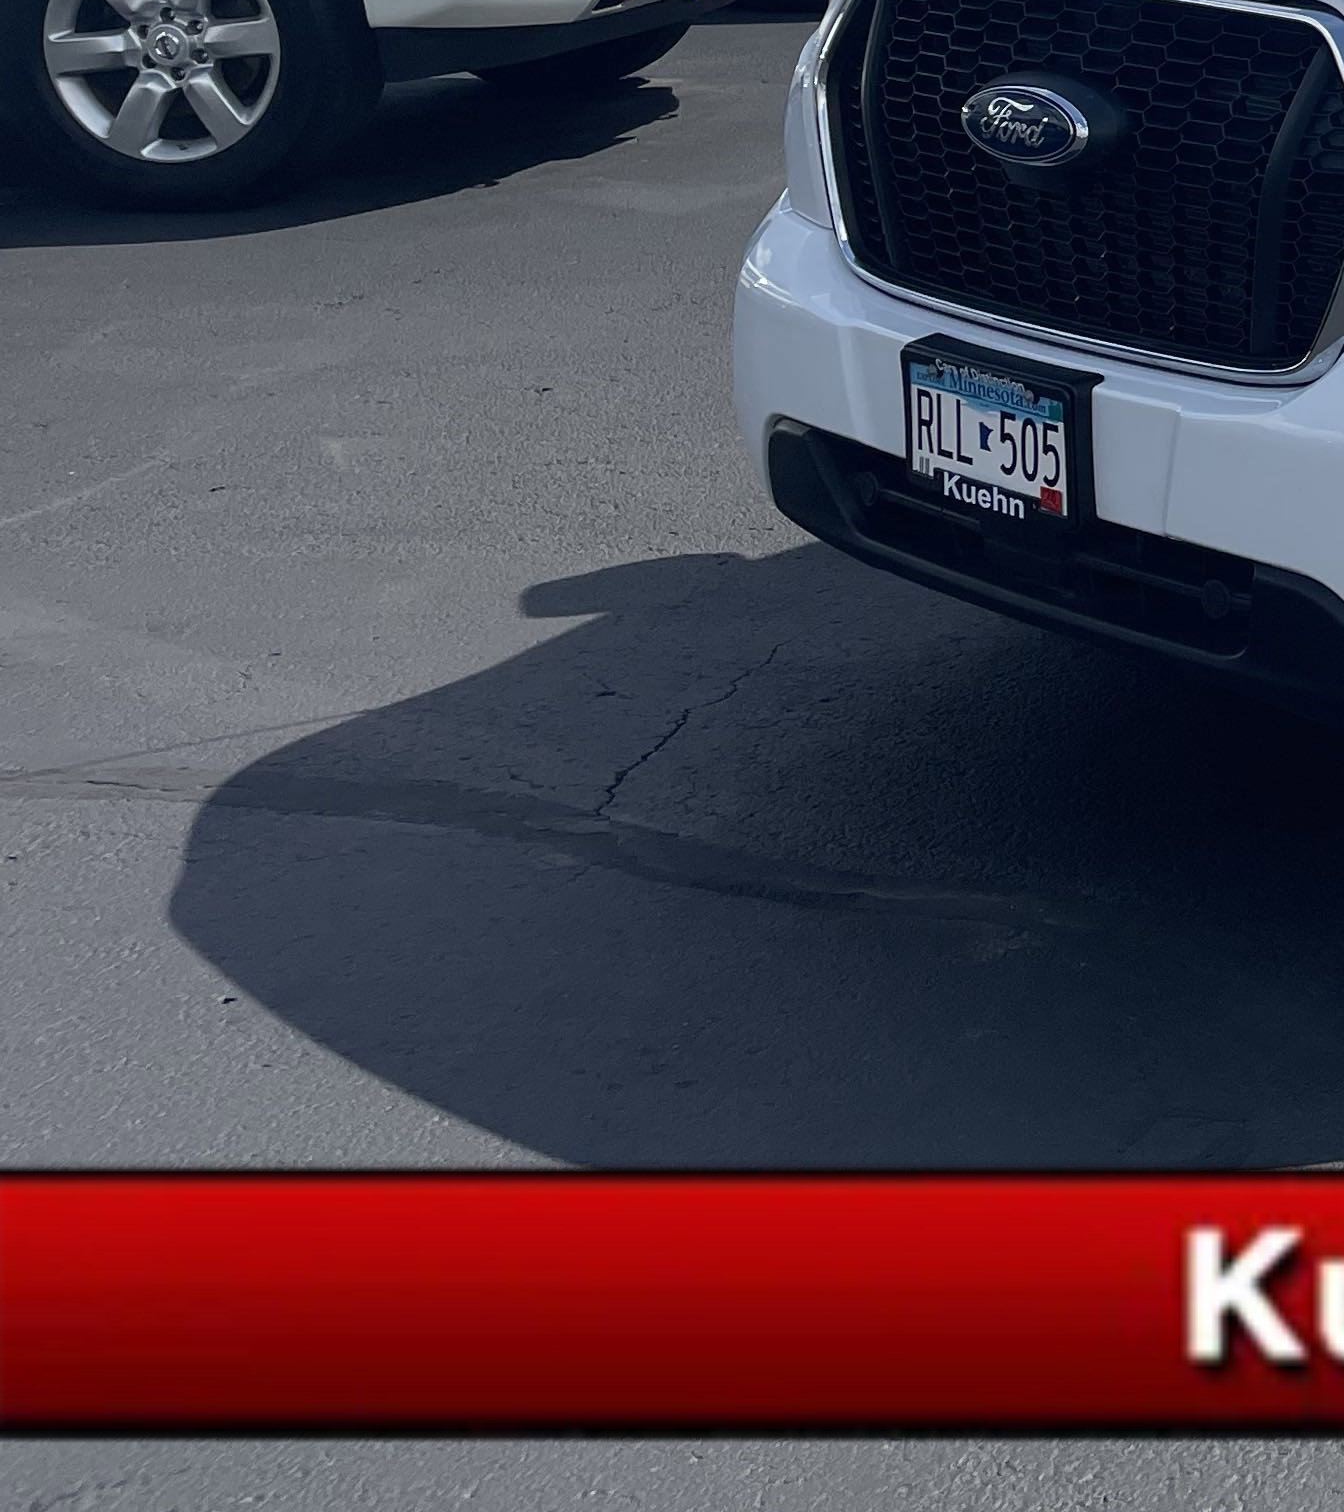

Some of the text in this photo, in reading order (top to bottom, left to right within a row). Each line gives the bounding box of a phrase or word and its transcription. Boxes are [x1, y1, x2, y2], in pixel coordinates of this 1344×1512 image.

[980, 96, 1049, 149] Ford
[916, 387, 1060, 488] RLL 505
[942, 471, 1025, 520] Kuehn
